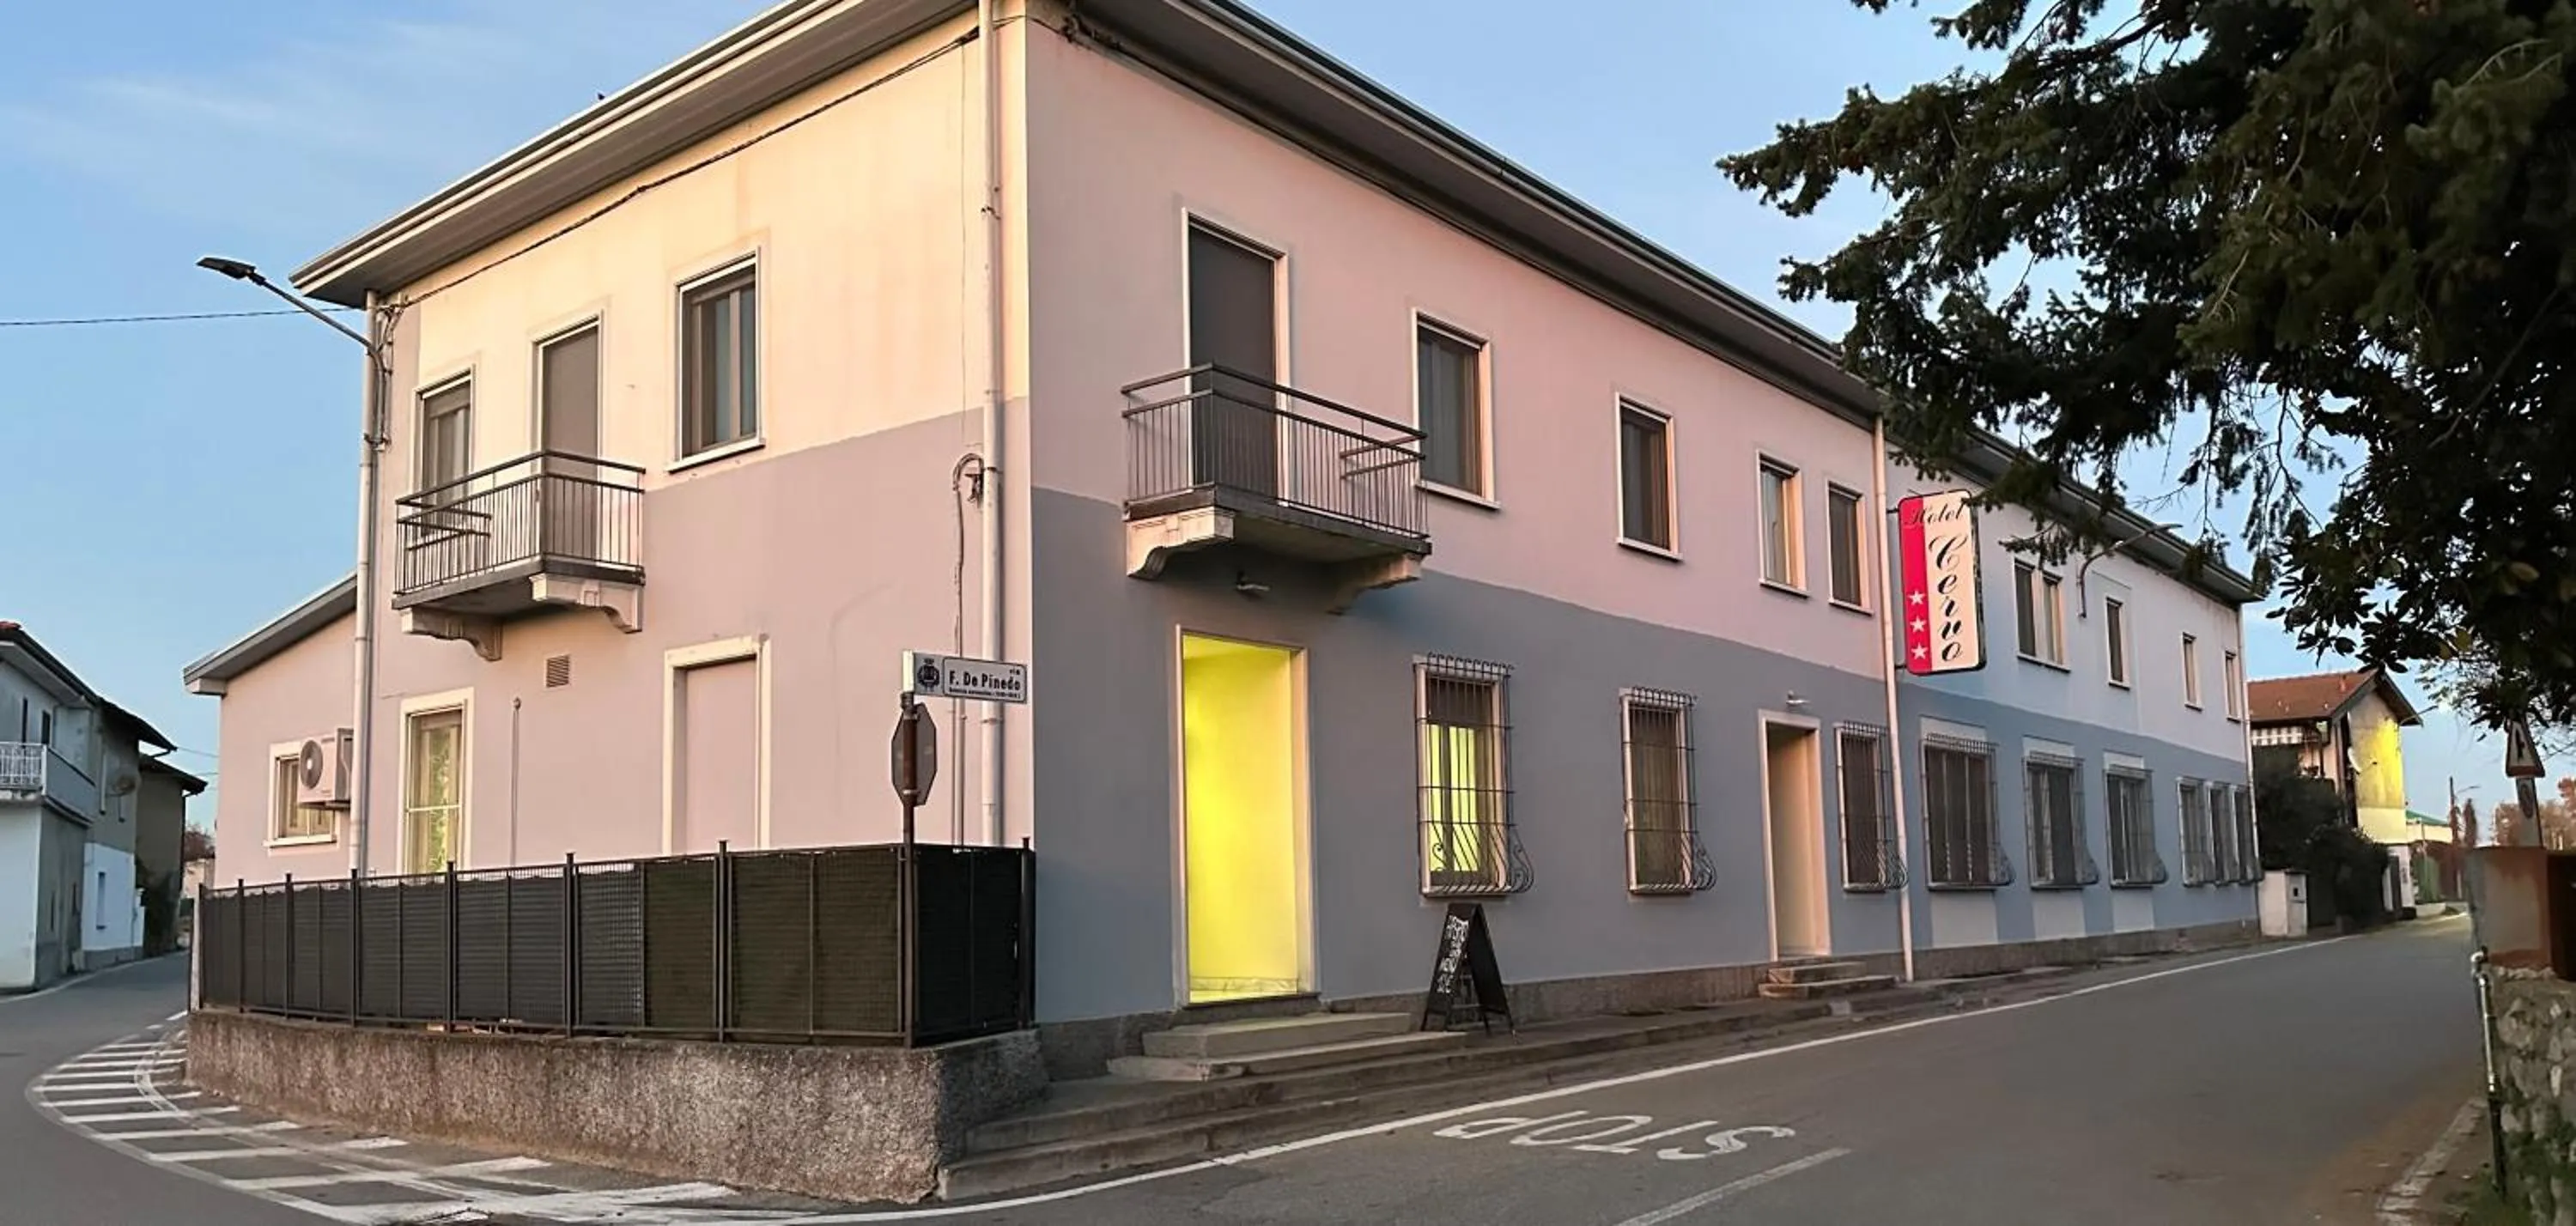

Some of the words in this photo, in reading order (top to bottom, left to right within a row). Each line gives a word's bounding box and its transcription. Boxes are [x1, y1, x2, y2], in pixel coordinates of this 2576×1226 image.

[1903, 501, 1966, 527] Hotel
[949, 671, 959, 685] F.
[963, 671, 978, 687] De
[981, 673, 1021, 691] Pinedo
[1433, 1110, 1795, 1160] STOP
